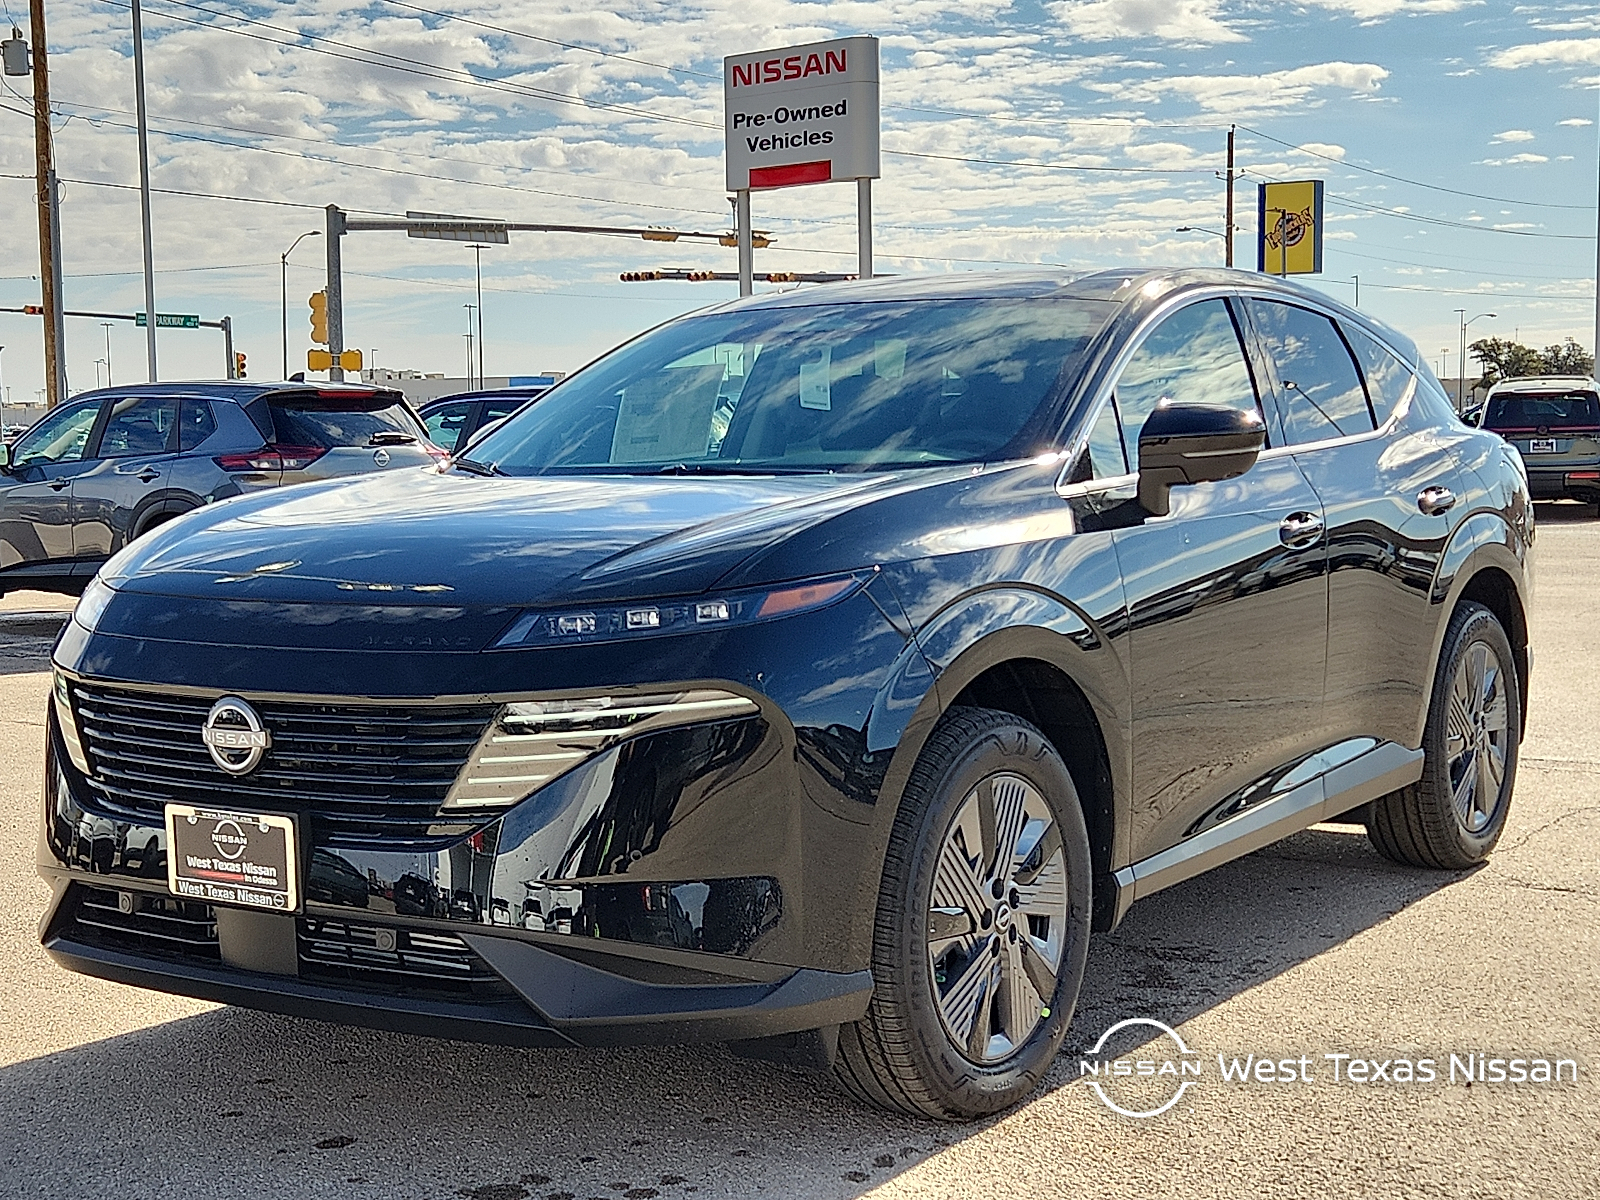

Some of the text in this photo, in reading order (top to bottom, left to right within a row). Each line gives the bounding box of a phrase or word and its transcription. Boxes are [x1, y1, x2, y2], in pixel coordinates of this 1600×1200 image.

[732, 49, 847, 88] NISSAN
[733, 99, 847, 130] Pre-Owned
[746, 130, 834, 153] Vehicles
[156, 315, 185, 326] PARKWAY
[202, 728, 264, 746] NISSAN
[211, 833, 248, 845] NISSAN
[186, 855, 277, 877] West Texas Nissan
[178, 880, 273, 906] West Texas Nissan
